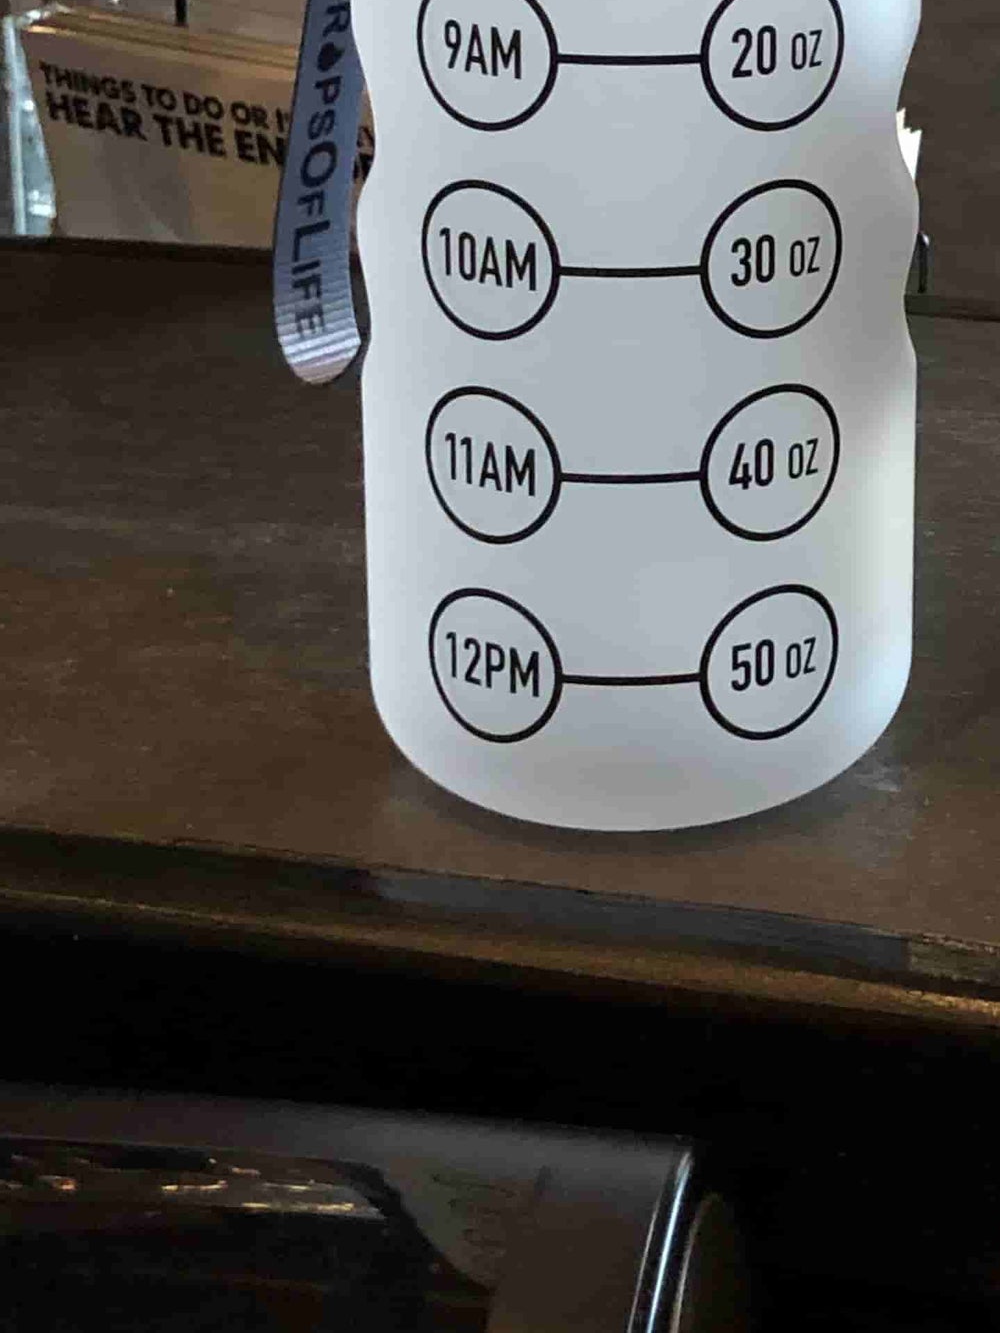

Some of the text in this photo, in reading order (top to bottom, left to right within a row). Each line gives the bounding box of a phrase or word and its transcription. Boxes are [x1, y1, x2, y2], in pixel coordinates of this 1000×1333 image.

[444, 19, 522, 80] 9AM
[731, 25, 777, 79] 20
[39, 60, 137, 103] THINGS
[141, 83, 177, 112] TO
[184, 91, 223, 117] DO
[230, 101, 269, 126] OR
[45, 91, 148, 142] HEAR
[152, 113, 227, 158] THE
[439, 227, 537, 292] 10AM
[730, 234, 776, 287] 30
[444, 432, 536, 497] 11AM
[728, 438, 775, 491] 40
[445, 631, 540, 698] 12PM
[731, 638, 775, 692] 50
